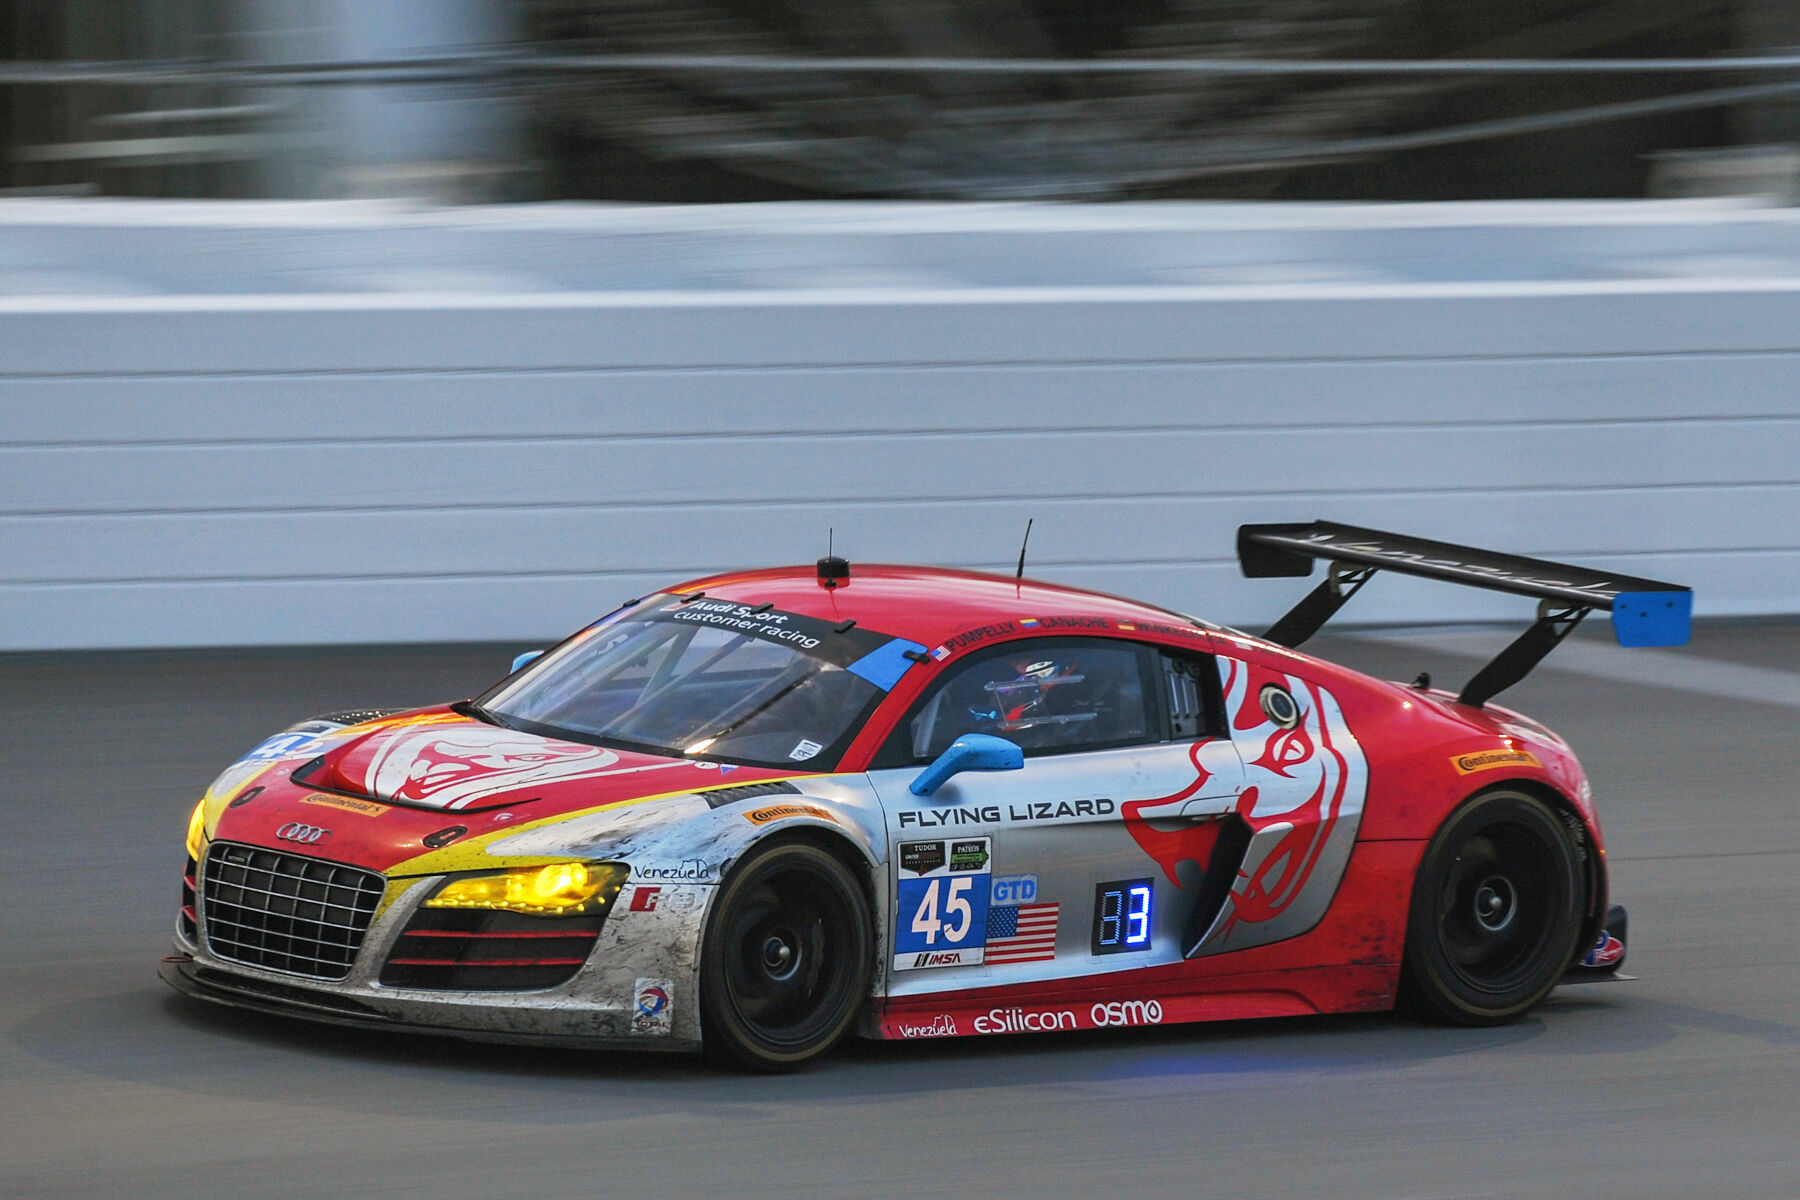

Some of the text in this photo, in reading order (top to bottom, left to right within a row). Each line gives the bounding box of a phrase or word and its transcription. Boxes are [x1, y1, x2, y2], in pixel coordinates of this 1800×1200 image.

[689, 600, 734, 613] Audi
[673, 611, 821, 649] customer racing
[945, 621, 1017, 650] PUMPELLY
[1040, 616, 1110, 628] CANACHE
[899, 798, 1114, 828] FLYING LIZARD
[914, 844, 937, 852] TUDOR
[634, 859, 712, 879] Venezuela
[993, 877, 1035, 899] GTD
[911, 876, 973, 944] 45
[928, 952, 962, 965] IMSA
[898, 1015, 958, 1038] Venezuela
[973, 1008, 1077, 1034] eSilicon
